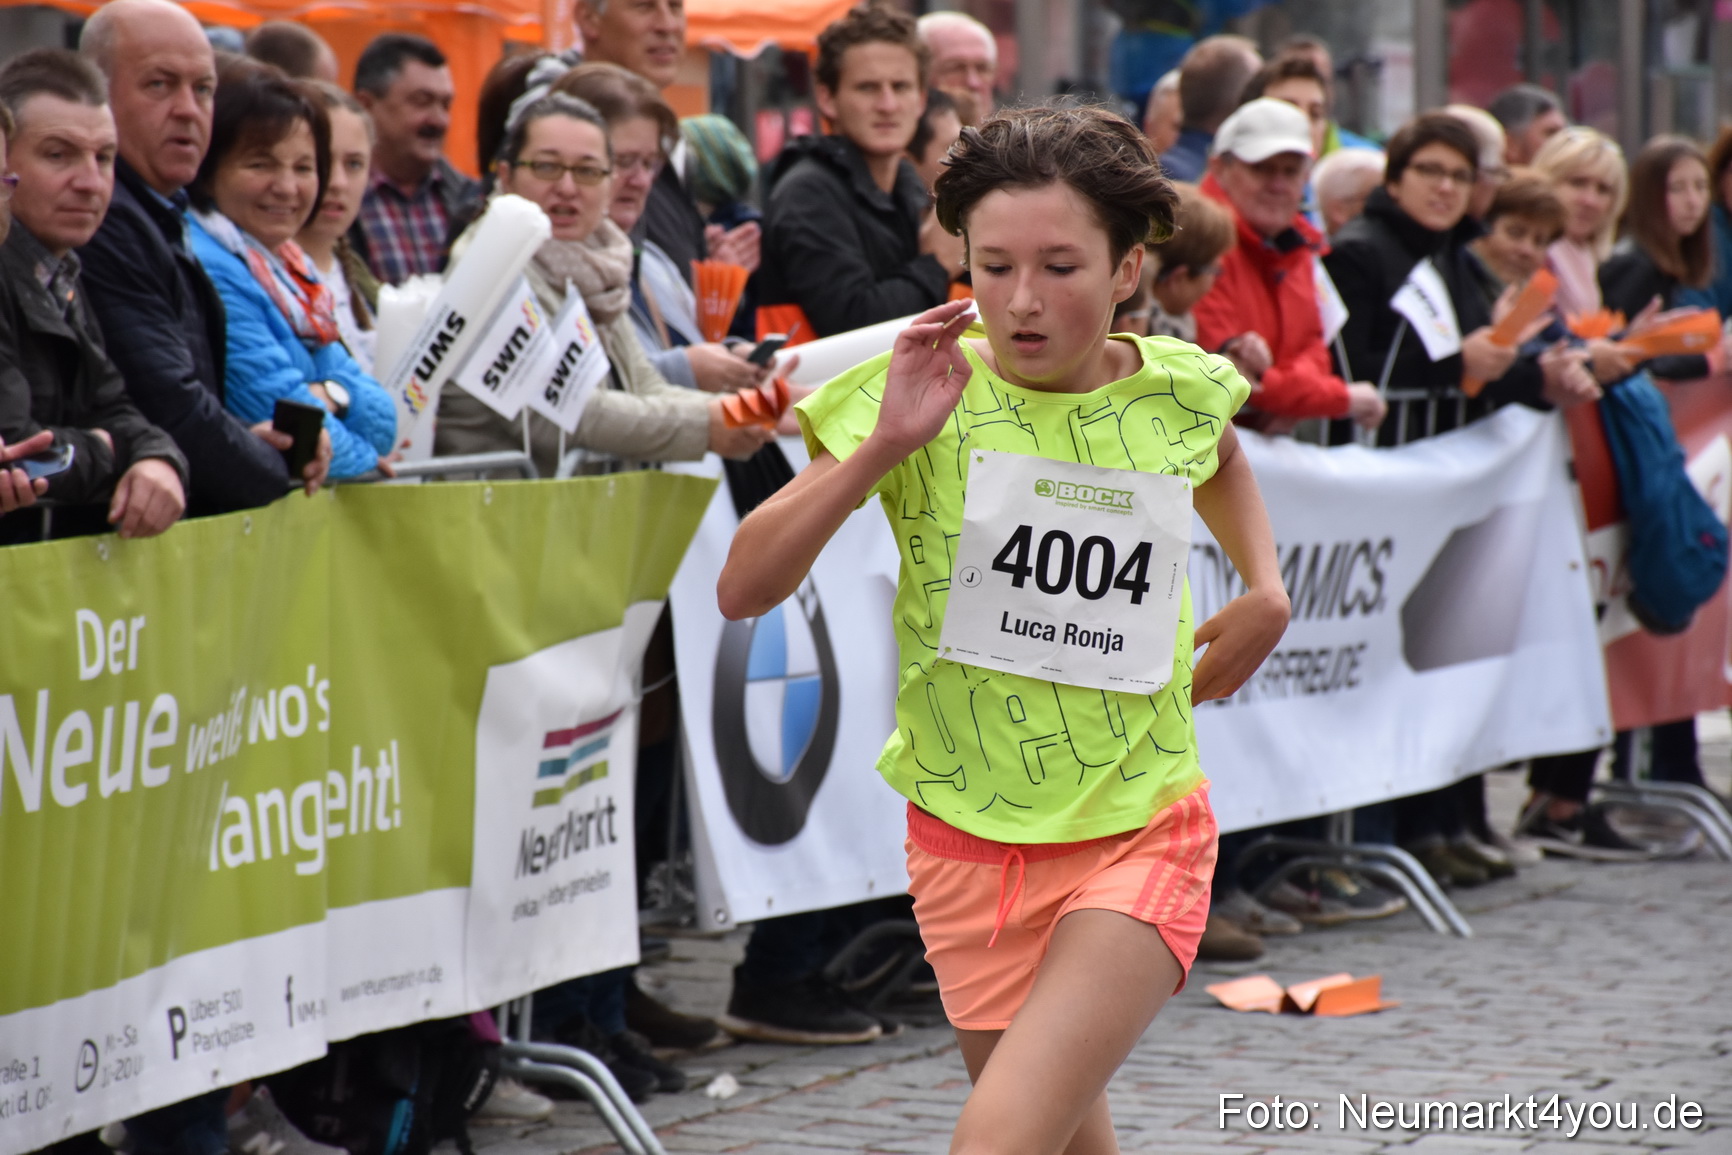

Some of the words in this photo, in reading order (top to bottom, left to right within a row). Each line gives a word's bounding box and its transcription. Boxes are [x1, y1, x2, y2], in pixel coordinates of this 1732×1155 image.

[1055, 499, 1078, 509] inspired
[1079, 503, 1087, 511] by
[1088, 505, 1105, 513] smart
[1106, 507, 1133, 517] concepts
[1056, 481, 1134, 509] BOCK
[966, 572, 975, 583] J
[991, 524, 1153, 605] 4004
[75, 608, 145, 681] Der
[1000, 611, 1055, 643] Luca
[1063, 623, 1124, 655] Ronja
[0, 688, 179, 813] Neue
